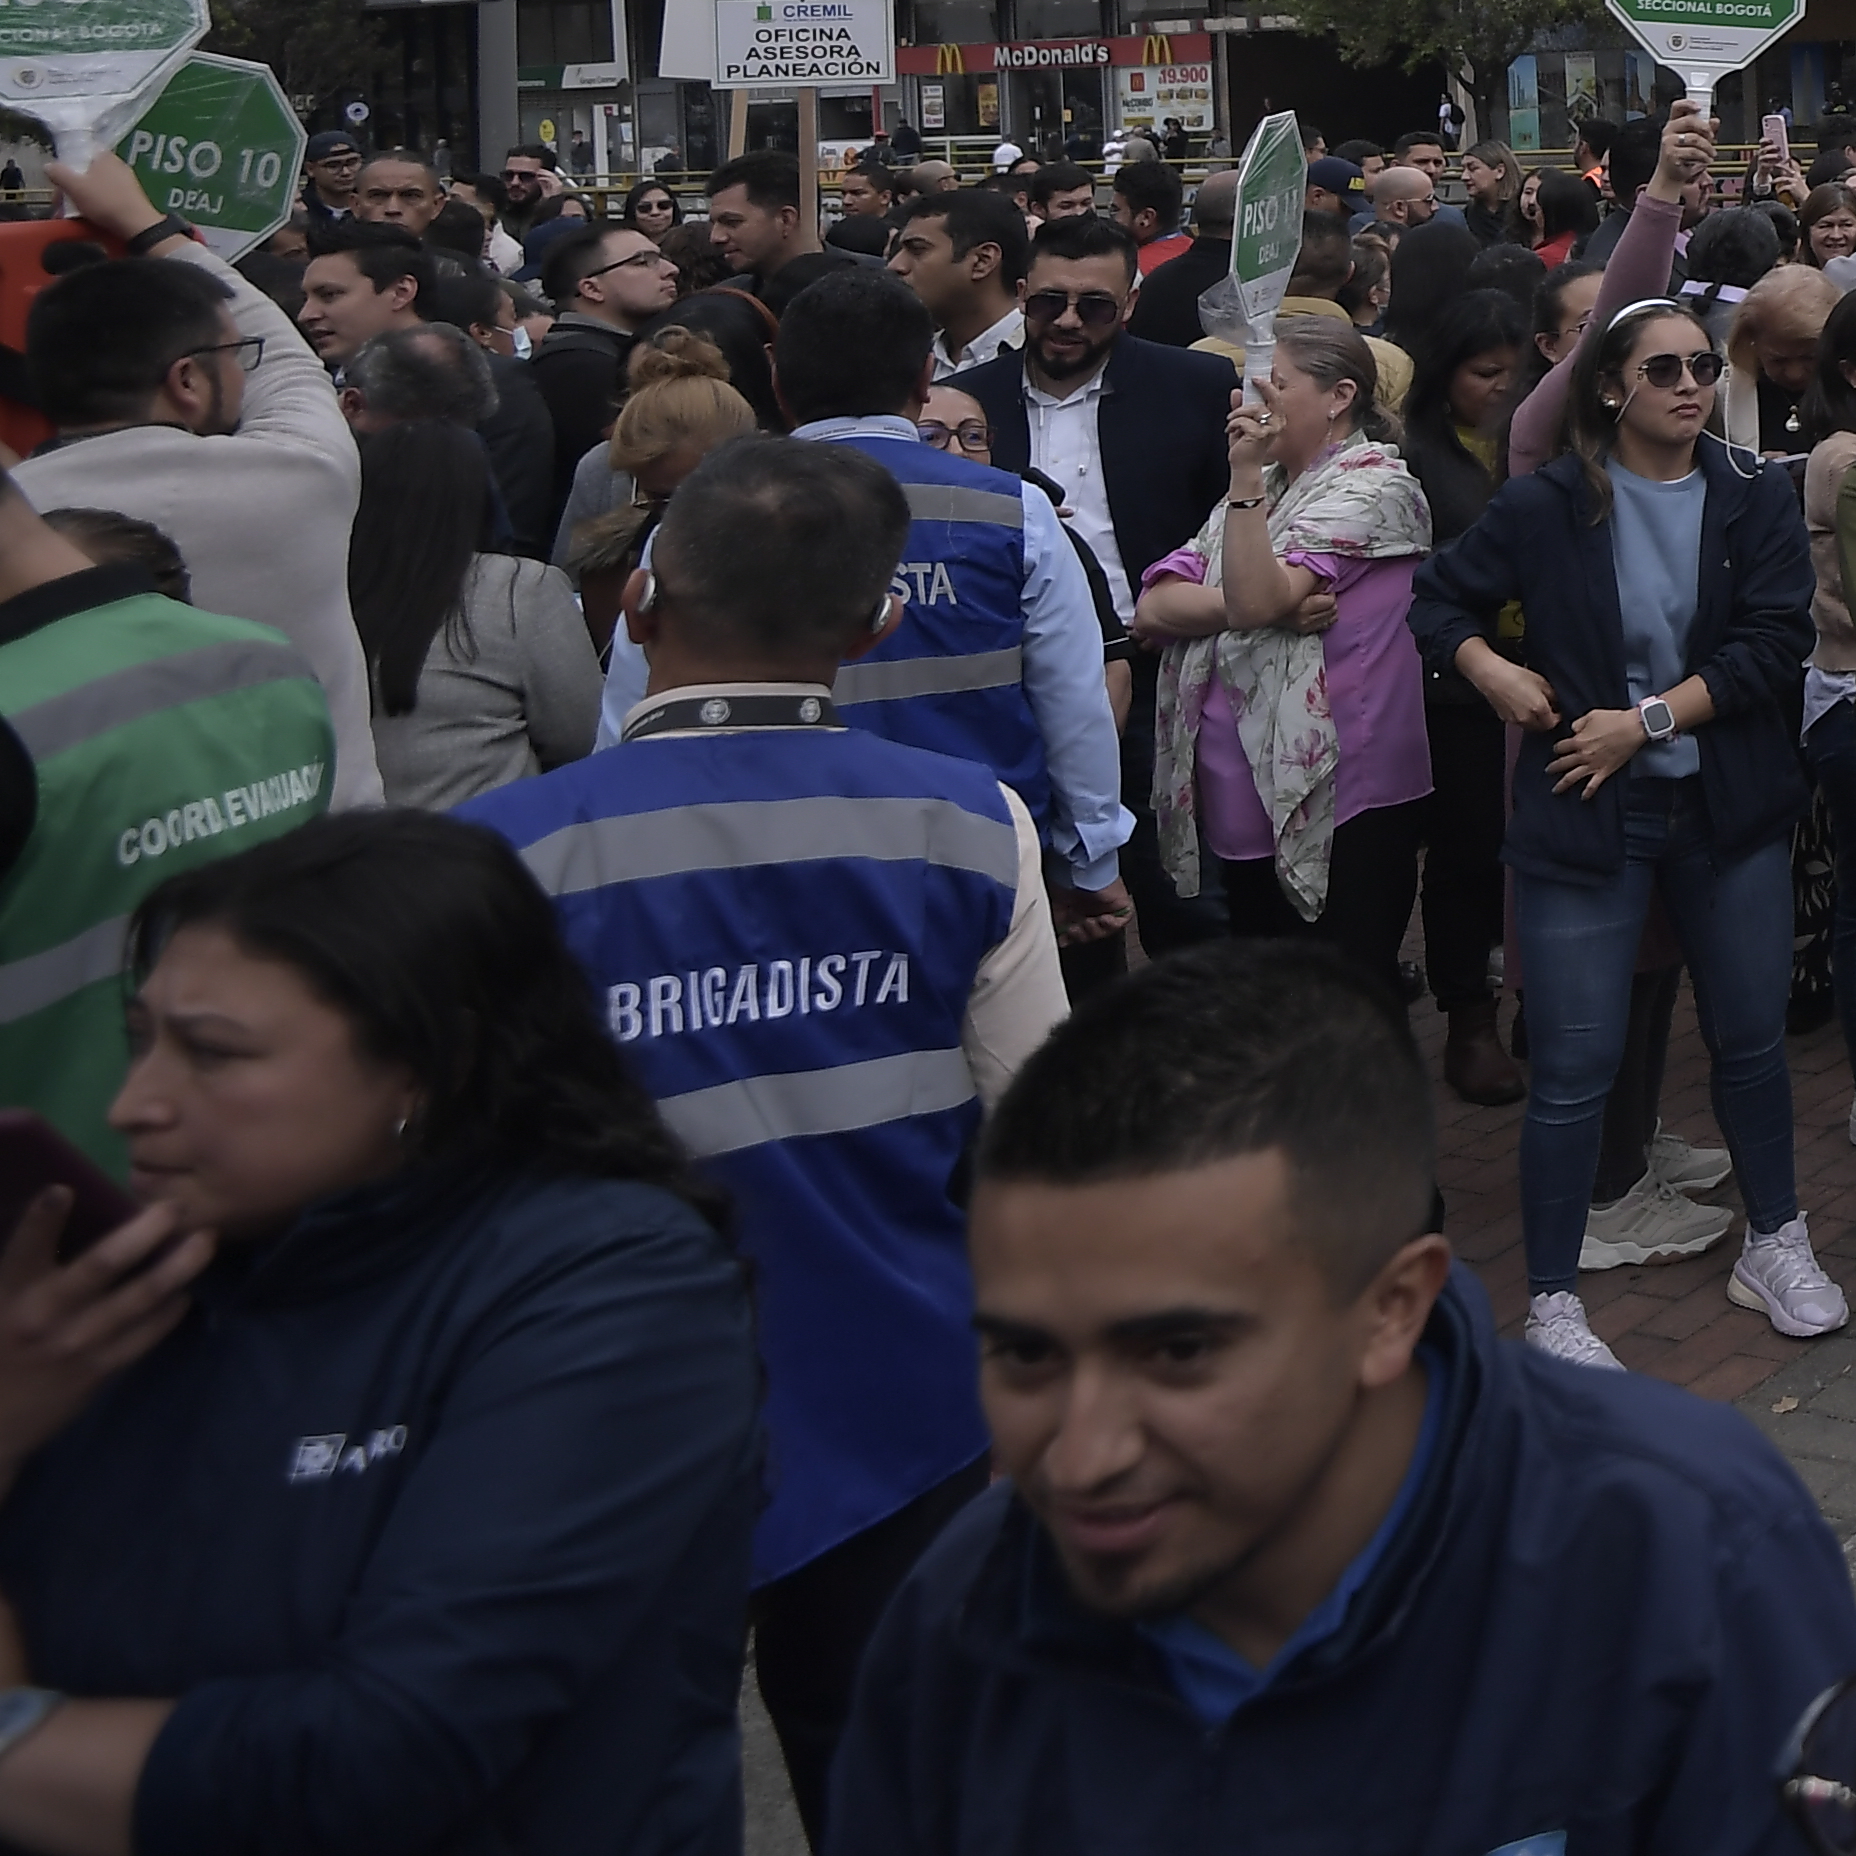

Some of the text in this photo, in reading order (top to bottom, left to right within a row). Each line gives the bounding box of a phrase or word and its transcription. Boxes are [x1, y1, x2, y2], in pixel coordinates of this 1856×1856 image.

[783, 4, 853, 18] CREMIL
[1716, 2, 1773, 17] BOGOTÁ
[755, 28, 852, 44] OFICINA
[745, 45, 862, 61] ASESORA
[994, 44, 1109, 68] McDonald's
[726, 58, 881, 79] PLANEACIÓN
[127, 129, 282, 189] PISO 10
[168, 188, 225, 215] DEAJ
[1243, 195, 1278, 239] PISO
[608, 949, 910, 1042] BRIGADISTA
